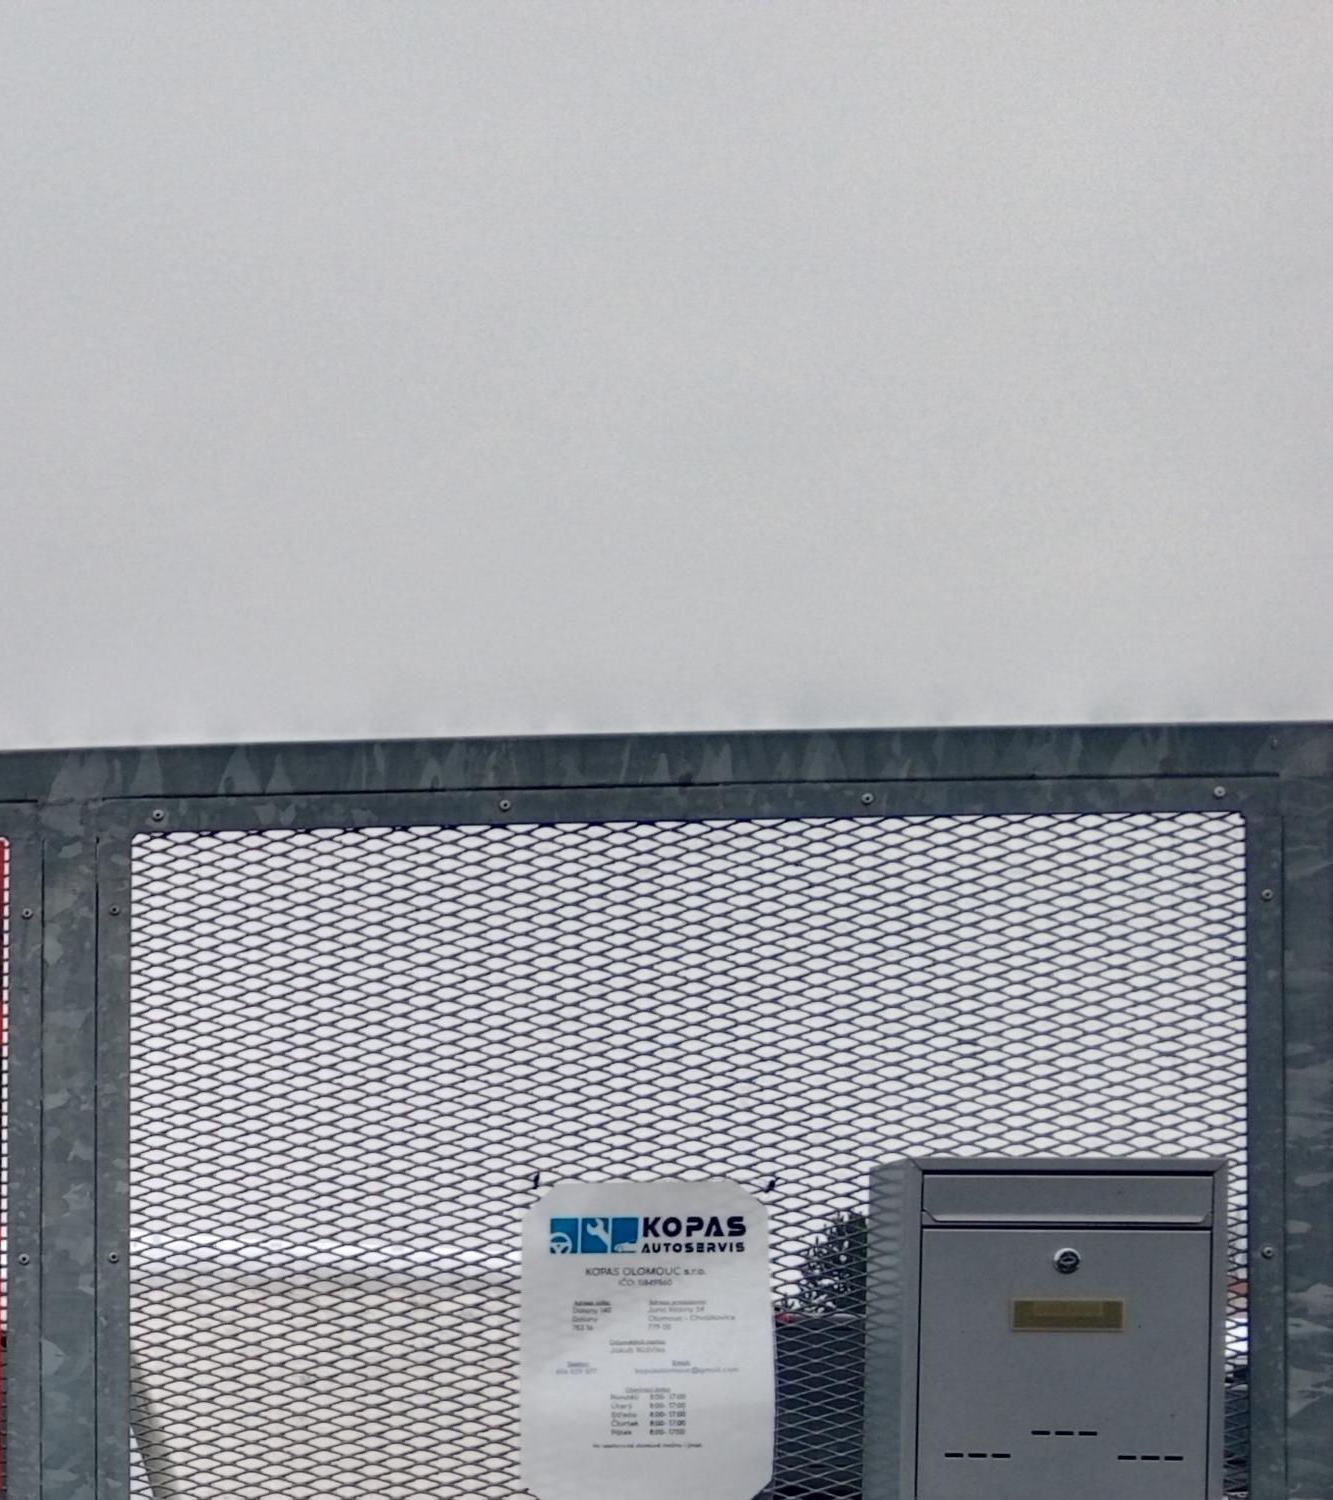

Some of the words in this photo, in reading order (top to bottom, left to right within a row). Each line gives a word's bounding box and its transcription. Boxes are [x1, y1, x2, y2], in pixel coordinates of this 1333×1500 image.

[641, 1216, 747, 1238] KOPAS
[641, 1242, 745, 1254] AUTOSERVIS
[585, 1267, 619, 1276] KOPAS
[623, 1267, 681, 1276] OLOMOUC
